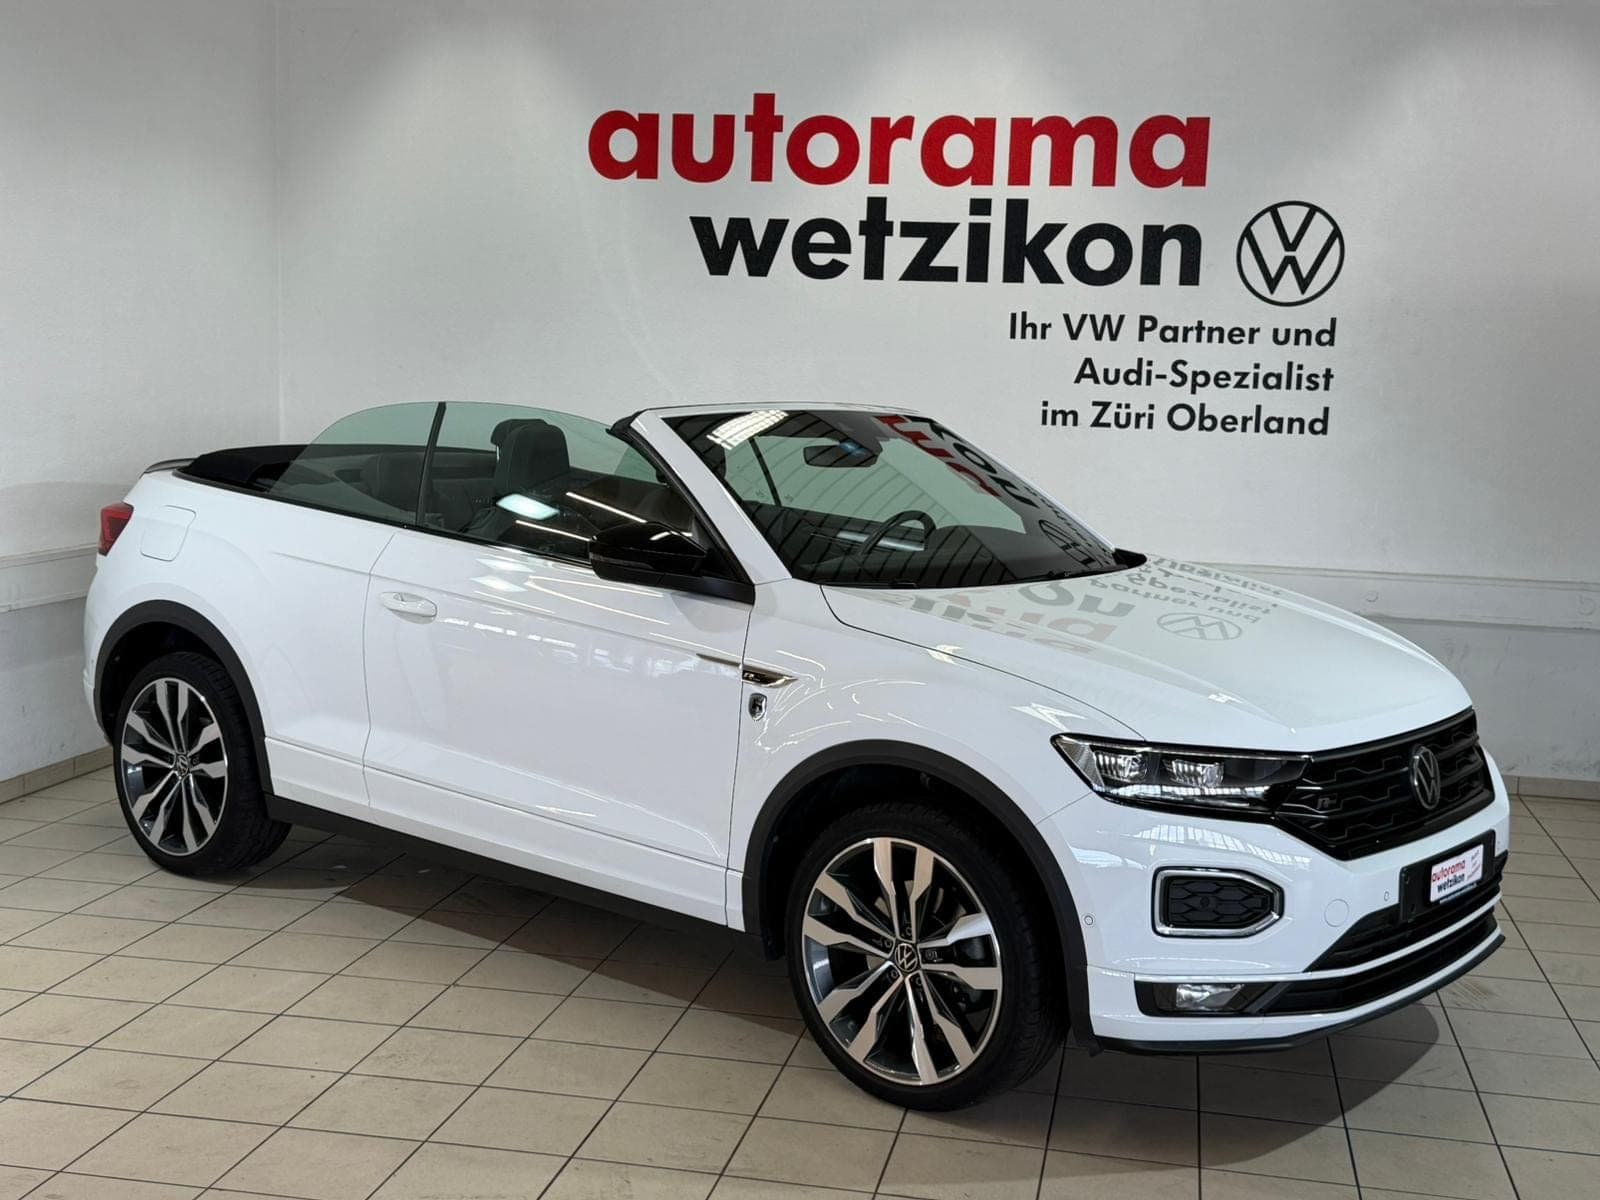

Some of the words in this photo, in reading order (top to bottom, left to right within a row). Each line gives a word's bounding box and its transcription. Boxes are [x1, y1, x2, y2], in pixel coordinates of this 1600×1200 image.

[589, 93, 1210, 188] autorama
[690, 197, 1201, 286] wetzikon
[1236, 201, 1345, 307] VW
[1007, 312, 1052, 340] Ihr
[1063, 314, 1125, 341] VW
[1139, 315, 1260, 344] Partner
[1273, 318, 1336, 346] und
[1074, 357, 1334, 395] Audi-Spezialist
[1040, 400, 1079, 427] im
[1090, 401, 1154, 429] Züri
[1167, 403, 1329, 435] Oberland
[1432, 859, 1466, 883] autorama
[1437, 873, 1465, 893] wetzikon
